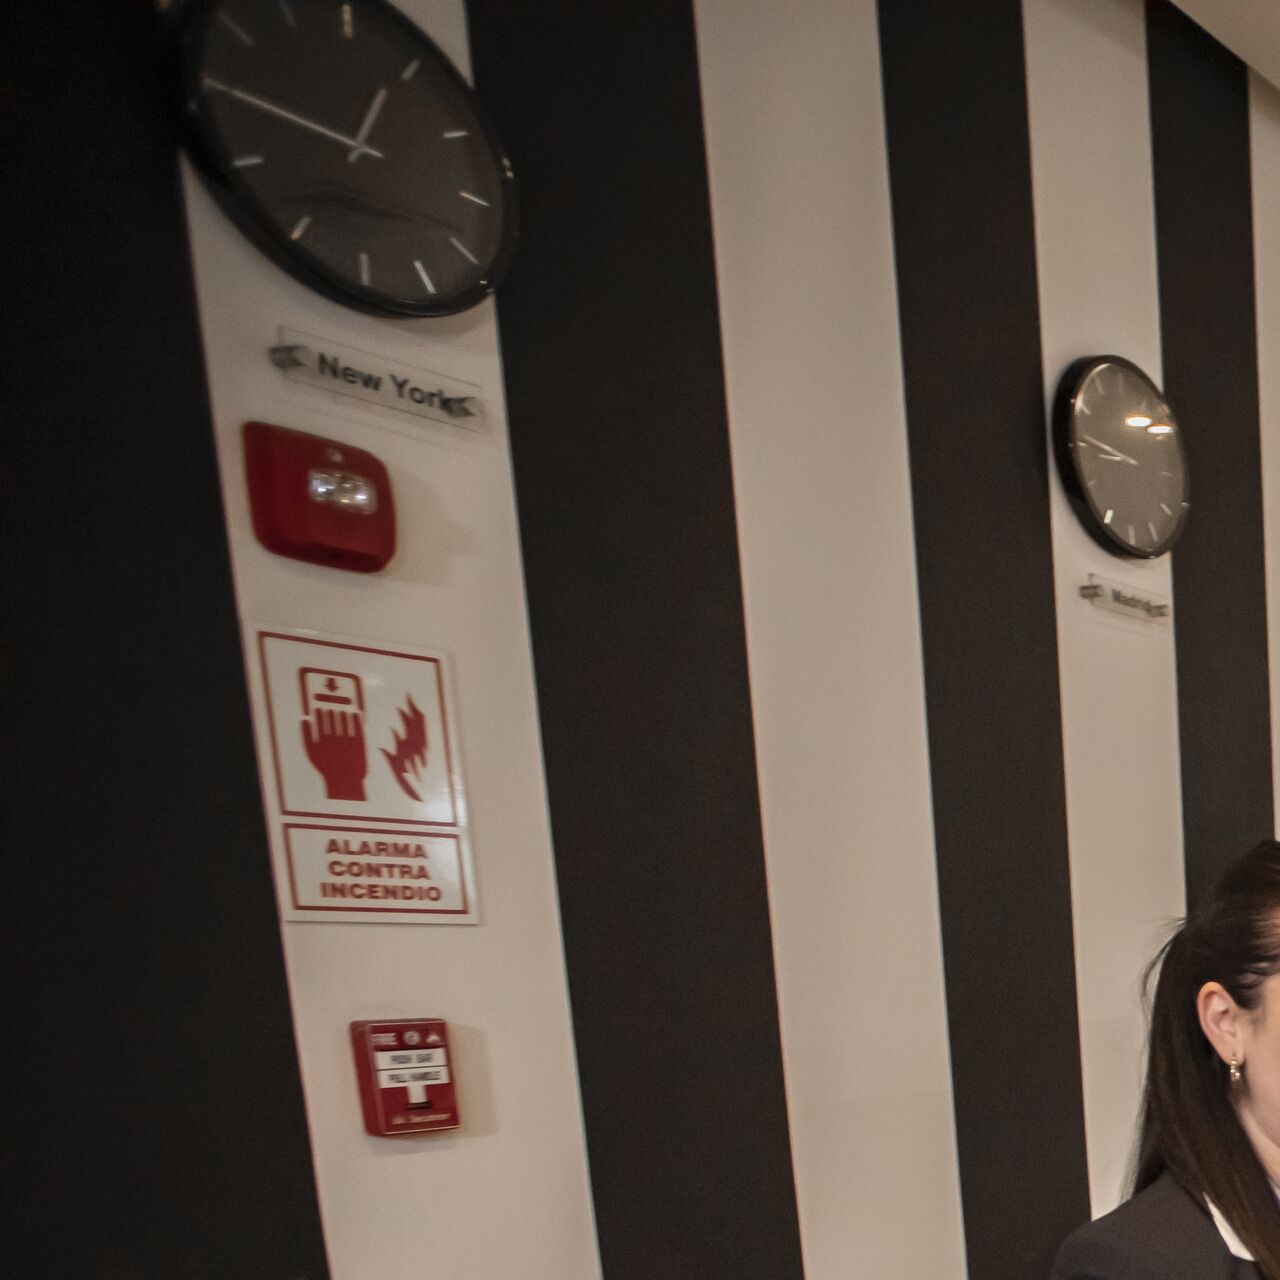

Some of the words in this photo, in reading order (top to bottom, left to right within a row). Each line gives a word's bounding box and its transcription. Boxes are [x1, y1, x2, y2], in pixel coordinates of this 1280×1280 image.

[318, 353, 381, 391] New
[326, 838, 427, 858] ALARMA
[329, 860, 430, 880] CONTRA
[320, 882, 441, 901] INCENDIO
